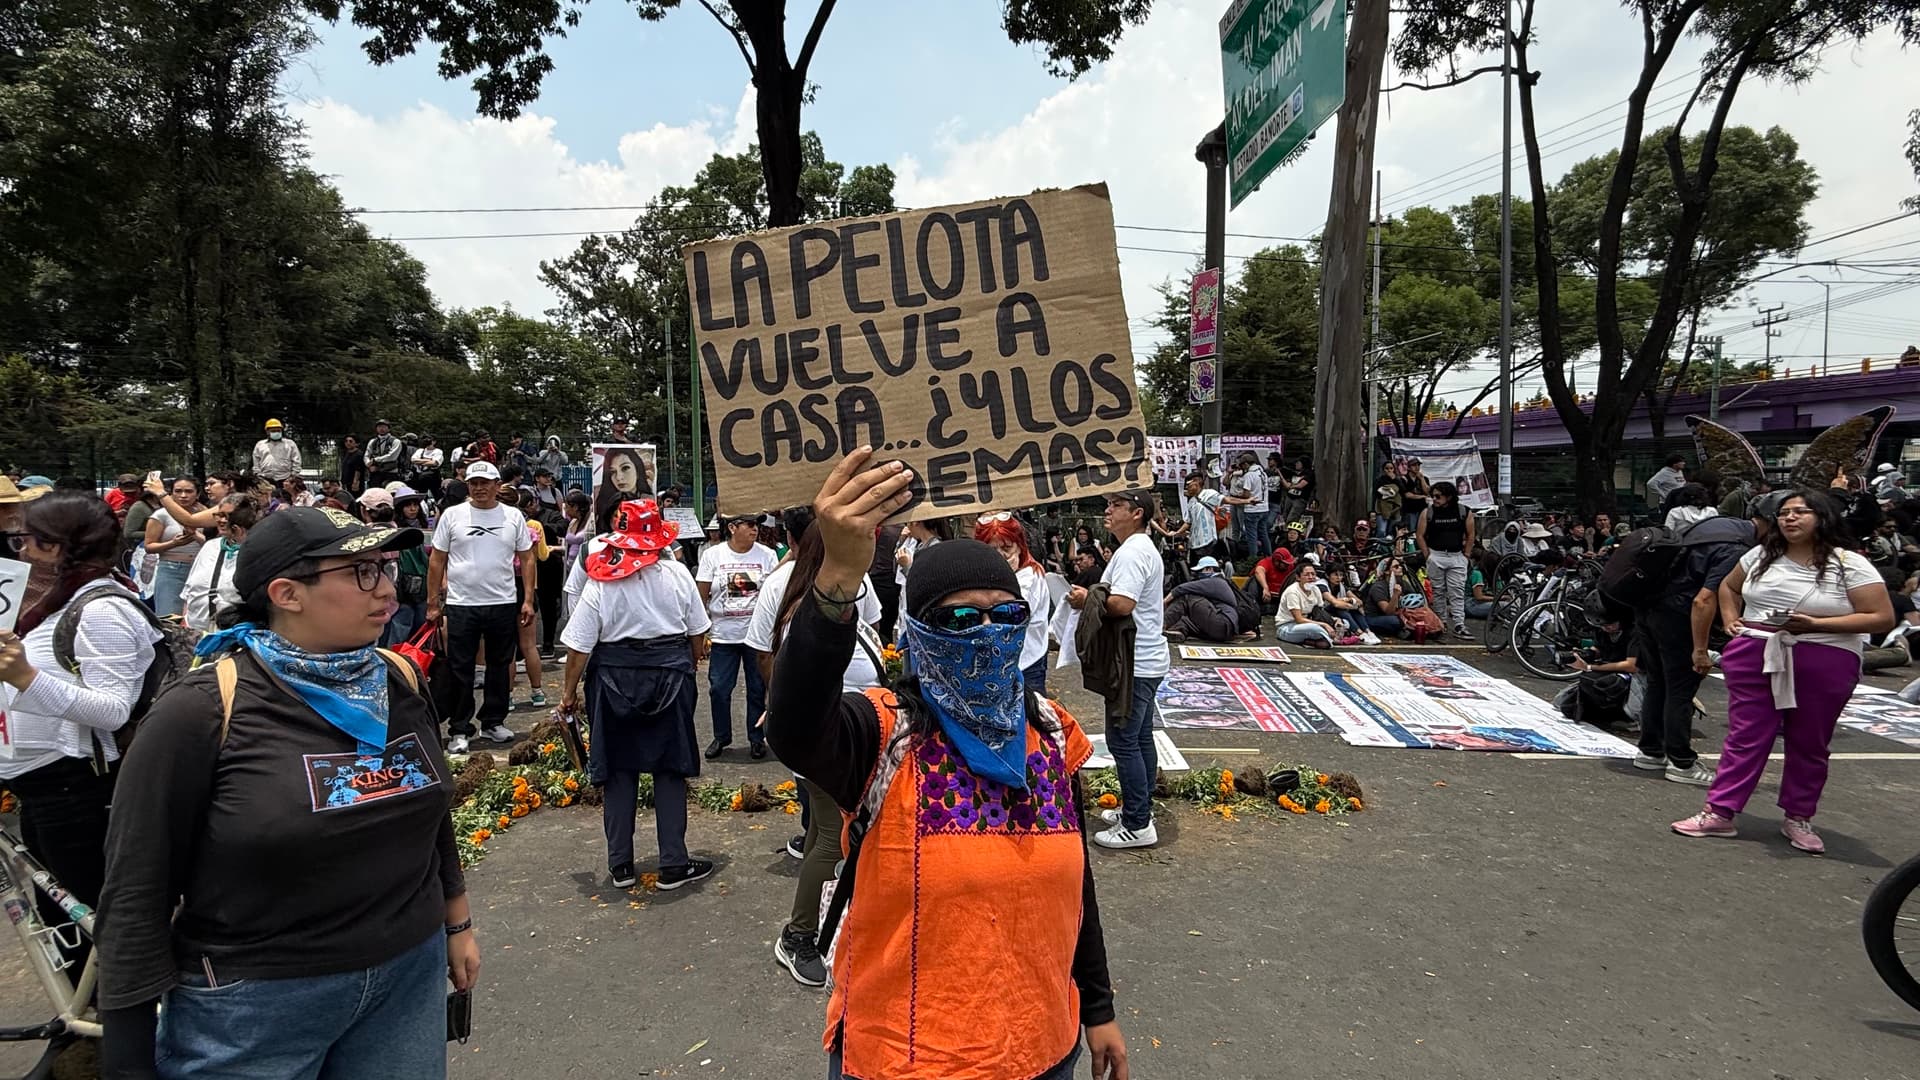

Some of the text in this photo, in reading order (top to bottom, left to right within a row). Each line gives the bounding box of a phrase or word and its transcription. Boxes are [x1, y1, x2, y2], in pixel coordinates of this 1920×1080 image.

[1244, 0, 1294, 69] AV AZTE
[1231, 21, 1302, 136] AV DEL IMAN
[1237, 103, 1288, 176] ESTADIO BANORTE
[693, 198, 1050, 331] LA PELOTA
[701, 292, 1050, 400] VUELVE A
[1010, 353, 1133, 433] LOS
[1236, 435, 1273, 443] BUSCA
[350, 767, 404, 788] KING
